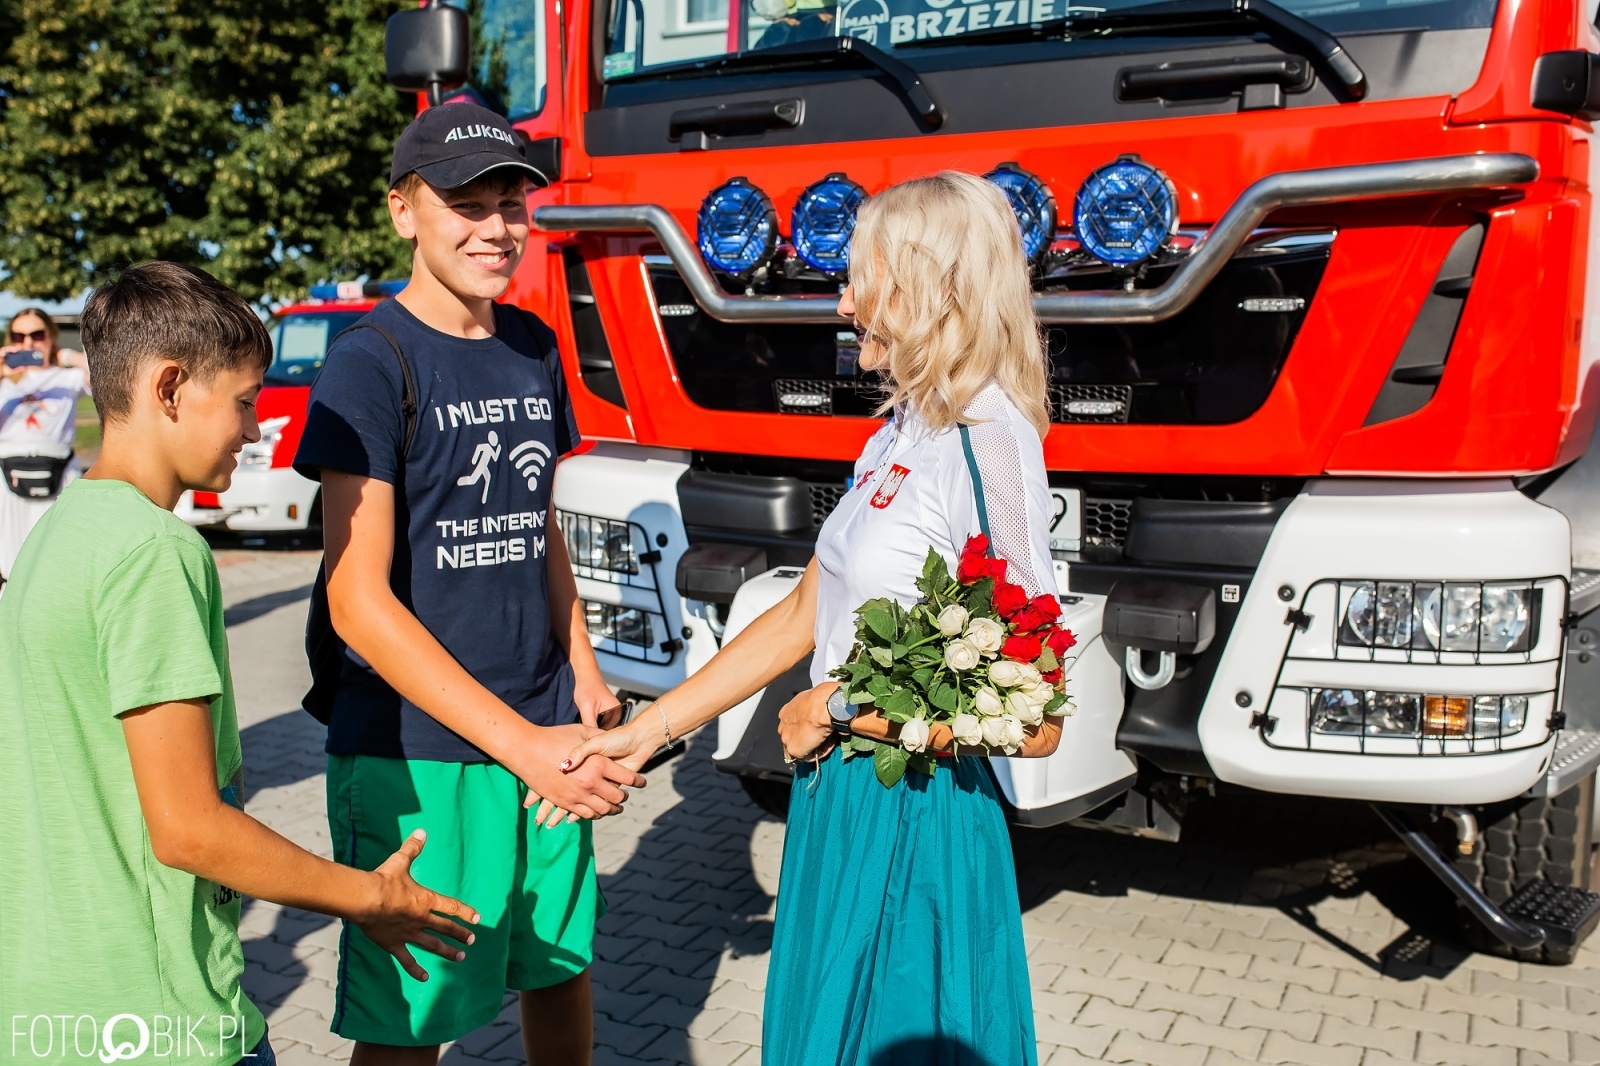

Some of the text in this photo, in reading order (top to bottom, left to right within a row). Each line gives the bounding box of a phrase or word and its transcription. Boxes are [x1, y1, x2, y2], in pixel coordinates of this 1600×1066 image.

[842, 13, 886, 28] MAN
[889, 0, 1054, 44] BRZEZIE
[444, 124, 515, 145] ALUKON
[435, 397, 552, 431] I MUST GO
[436, 518, 479, 538] THE
[436, 538, 526, 569] NEEDS
